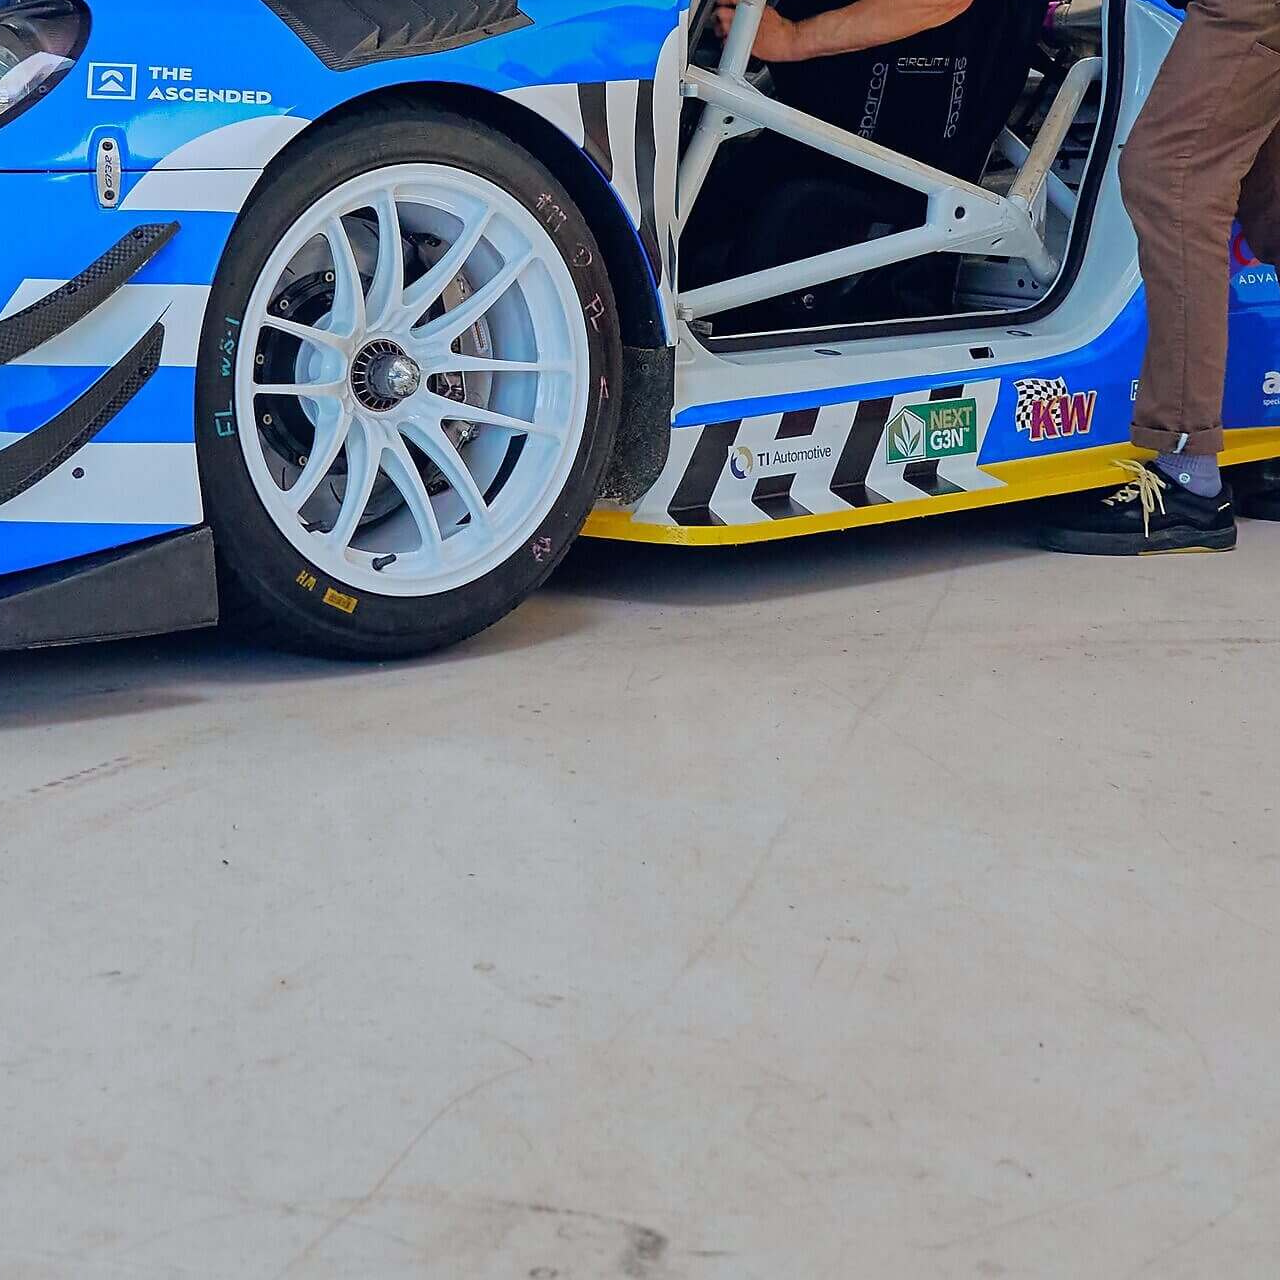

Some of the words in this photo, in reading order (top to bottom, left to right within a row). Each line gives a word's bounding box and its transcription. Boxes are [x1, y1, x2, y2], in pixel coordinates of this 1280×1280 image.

[148, 66, 193, 81] THE
[897, 57, 944, 67] CIRCUIT
[147, 86, 272, 105] ASCENDED
[946, 56, 968, 138] sparco
[214, 400, 235, 437] FL
[930, 407, 973, 431] NEXT
[1029, 390, 1098, 442] KW
[757, 453, 770, 467] TI
[772, 445, 832, 465] Automotive
